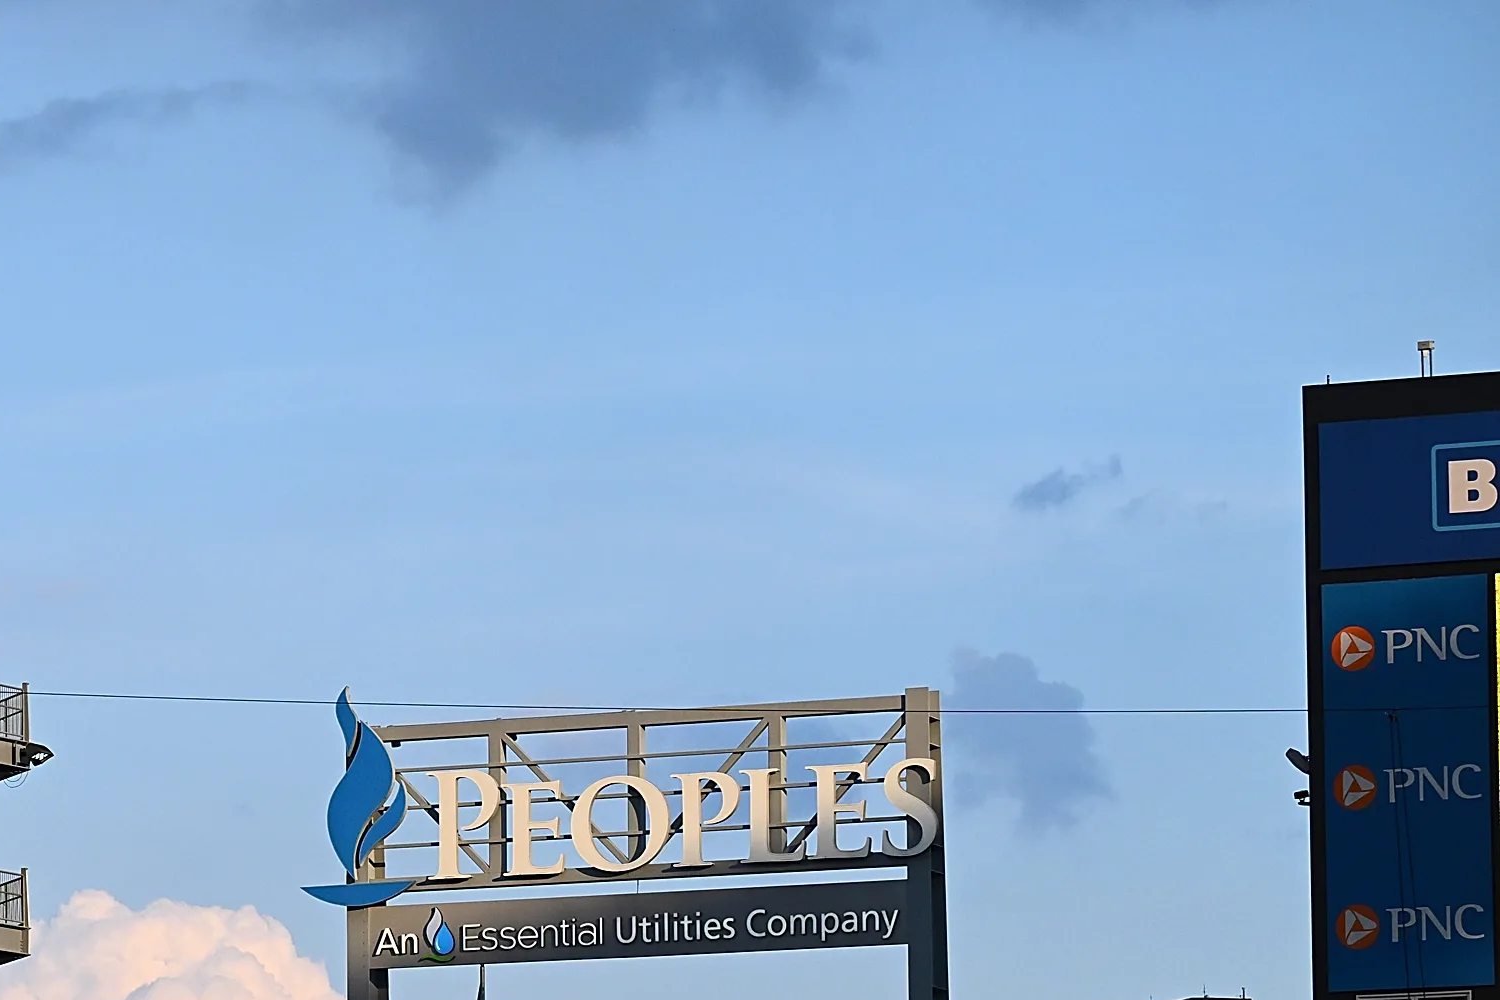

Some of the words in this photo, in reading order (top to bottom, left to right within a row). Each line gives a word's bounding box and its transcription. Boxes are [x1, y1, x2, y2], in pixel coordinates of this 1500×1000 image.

[1381, 624, 1481, 664] PNC
[1383, 763, 1482, 803] PNC
[426, 758, 940, 882] PEOPLES
[373, 927, 418, 956] An
[460, 916, 605, 952] Essential
[614, 908, 737, 945] Utilities
[745, 907, 900, 945] Company
[1386, 903, 1485, 943] PNC
